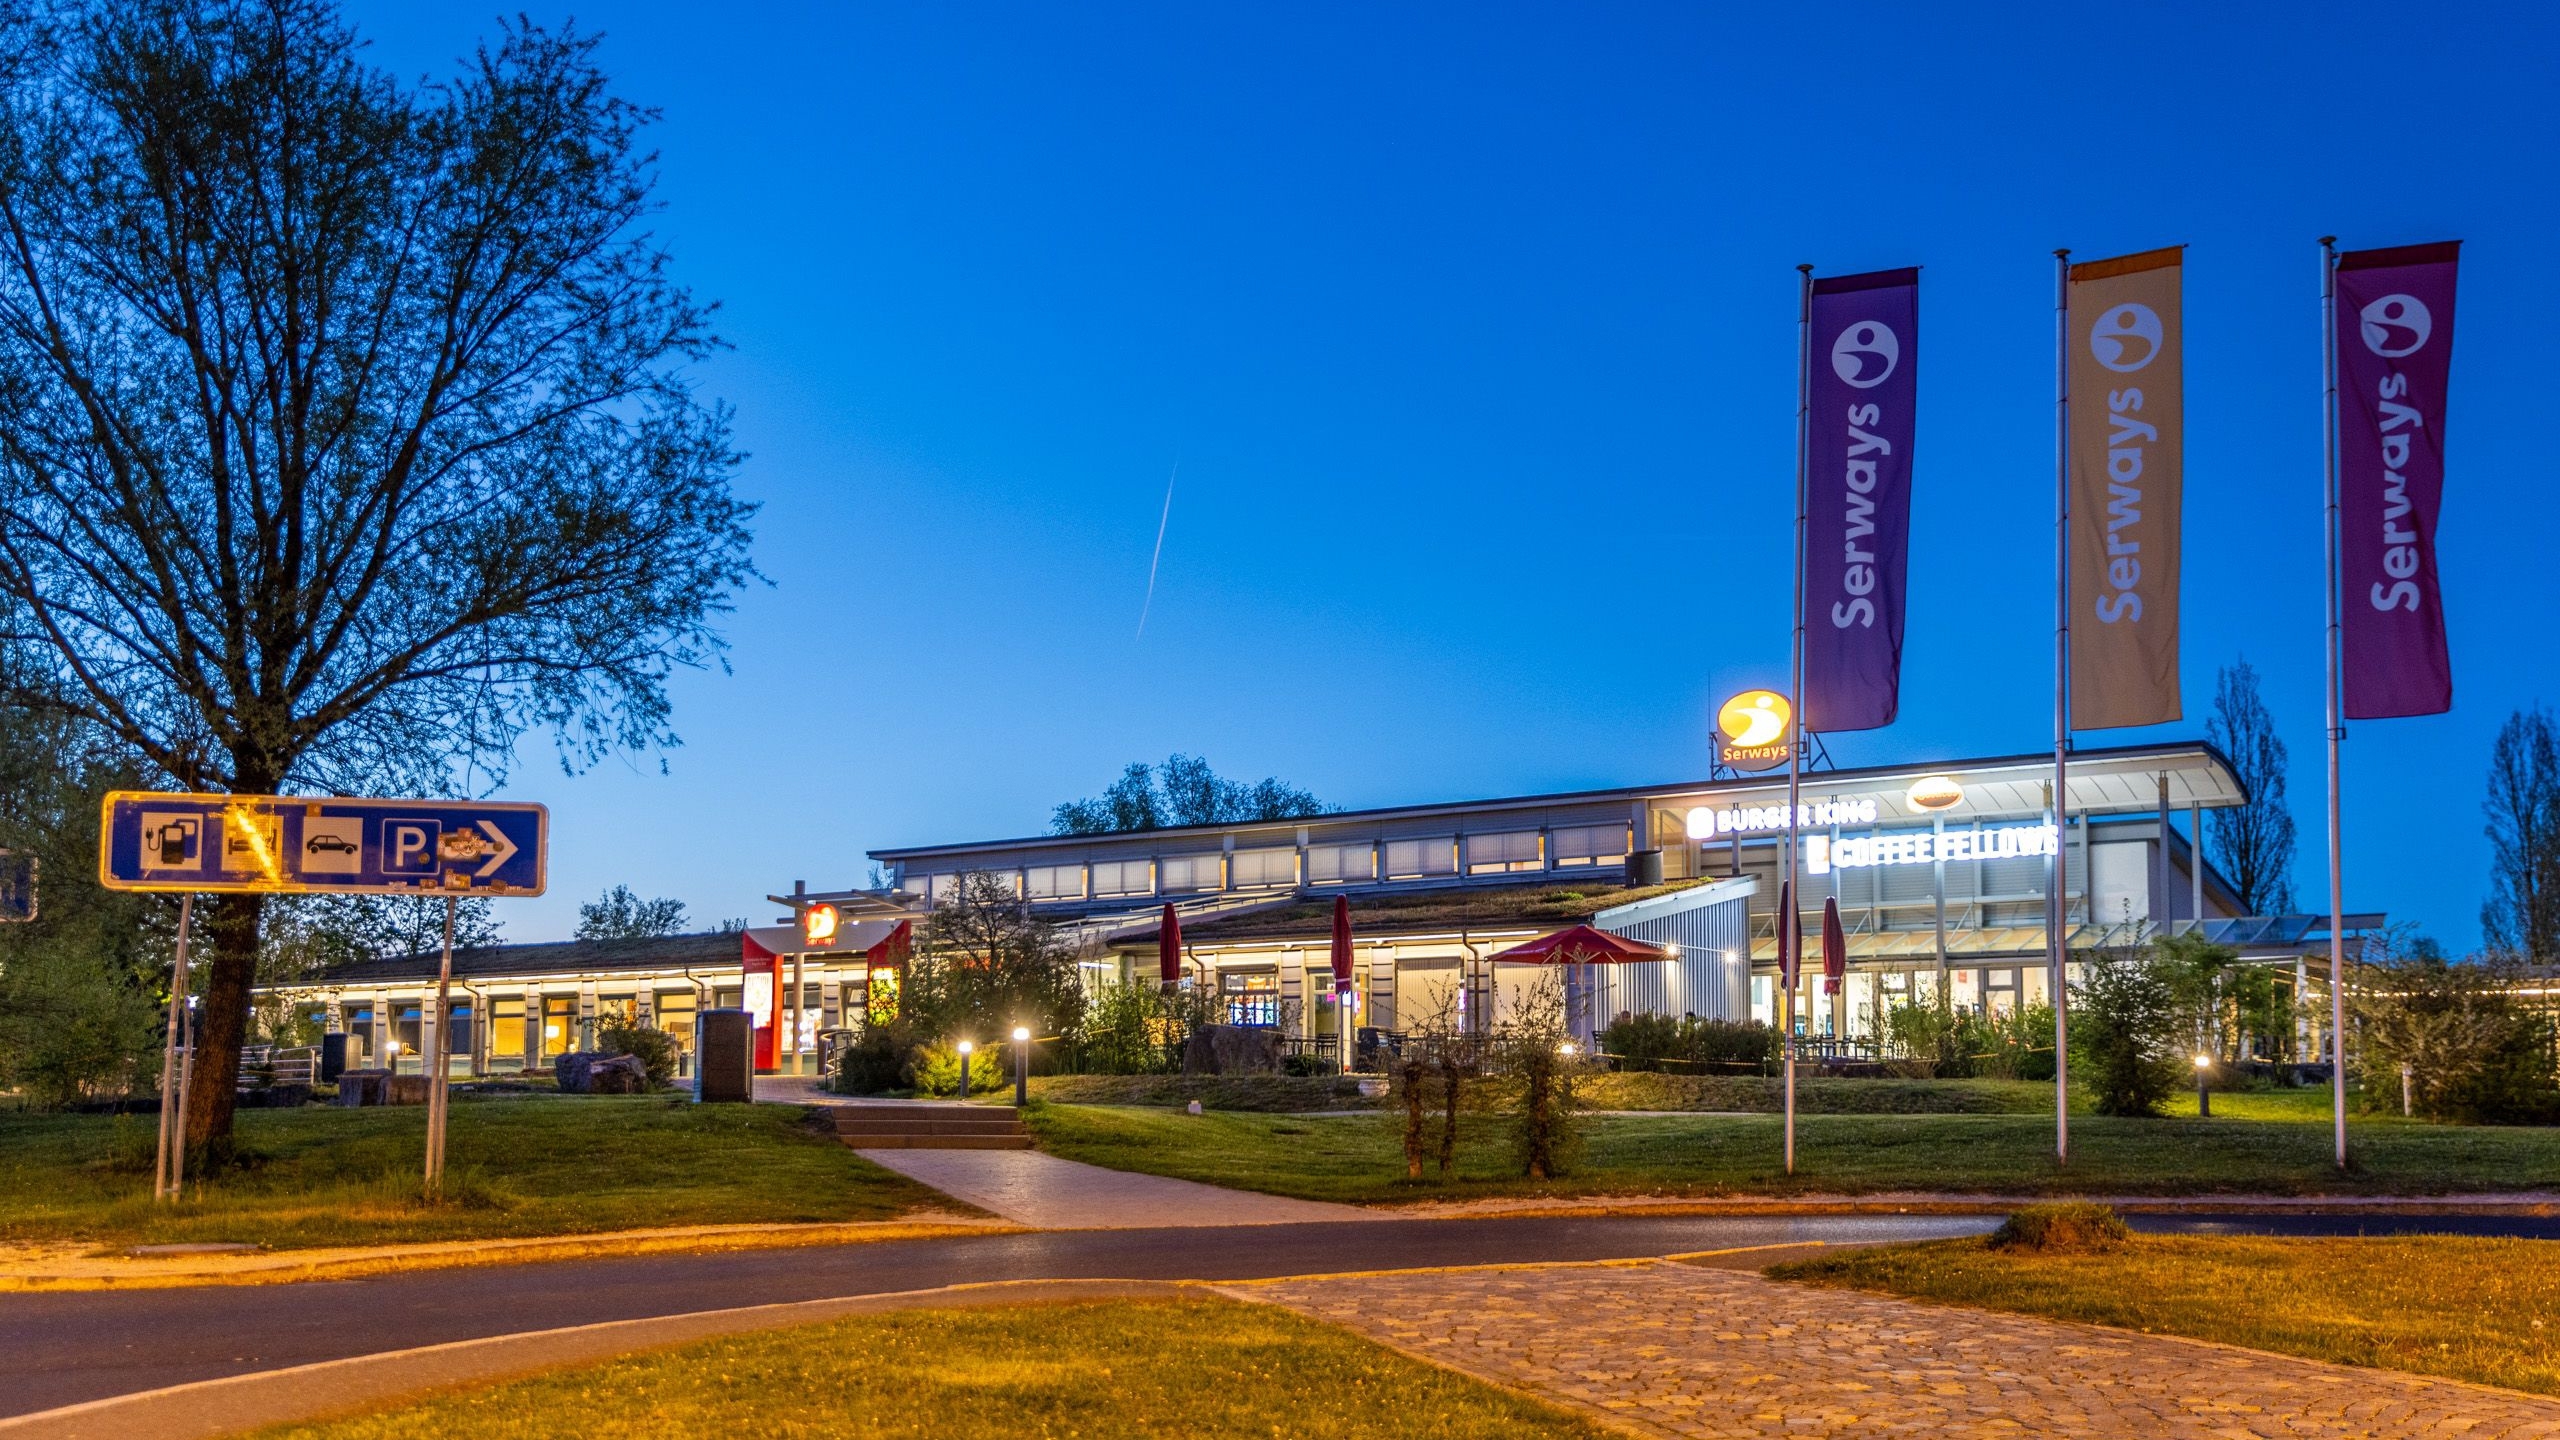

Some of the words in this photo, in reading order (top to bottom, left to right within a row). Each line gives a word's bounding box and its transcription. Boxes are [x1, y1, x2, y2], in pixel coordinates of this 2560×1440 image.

[2096, 388, 2157, 625] Serways
[2371, 373, 2422, 613] Serways
[1832, 404, 1890, 629] Serways
[1723, 745, 1788, 761] Serways
[1716, 804, 1810, 833] BURGER
[1814, 799, 1877, 826] KING
[396, 827, 427, 867] P
[1834, 833, 1932, 868] COFFEE
[1934, 824, 2059, 862] FELLOWS
[805, 936, 836, 946] Serways
